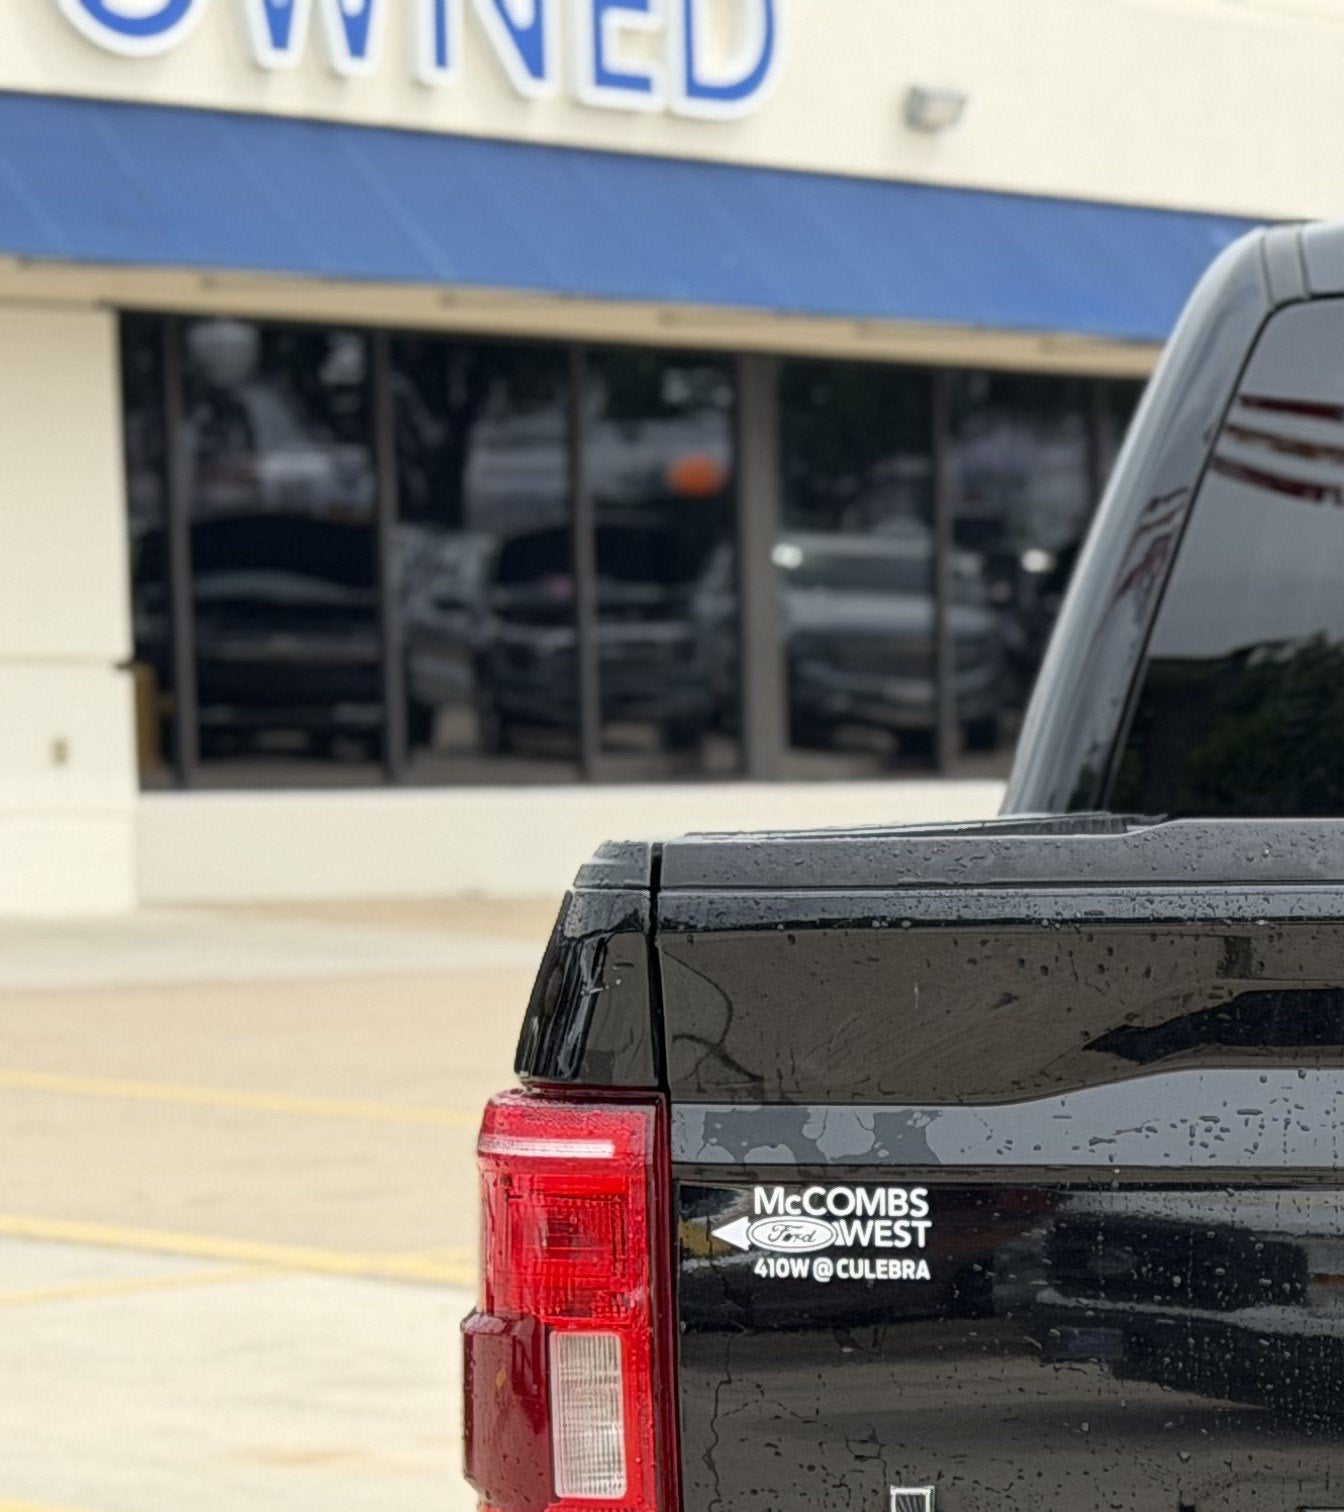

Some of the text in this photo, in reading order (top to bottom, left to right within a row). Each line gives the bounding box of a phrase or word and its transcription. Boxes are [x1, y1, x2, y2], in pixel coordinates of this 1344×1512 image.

[754, 1186, 929, 1217] McCOMBS
[767, 1224, 817, 1243] Ford
[839, 1220, 932, 1248] WEST
